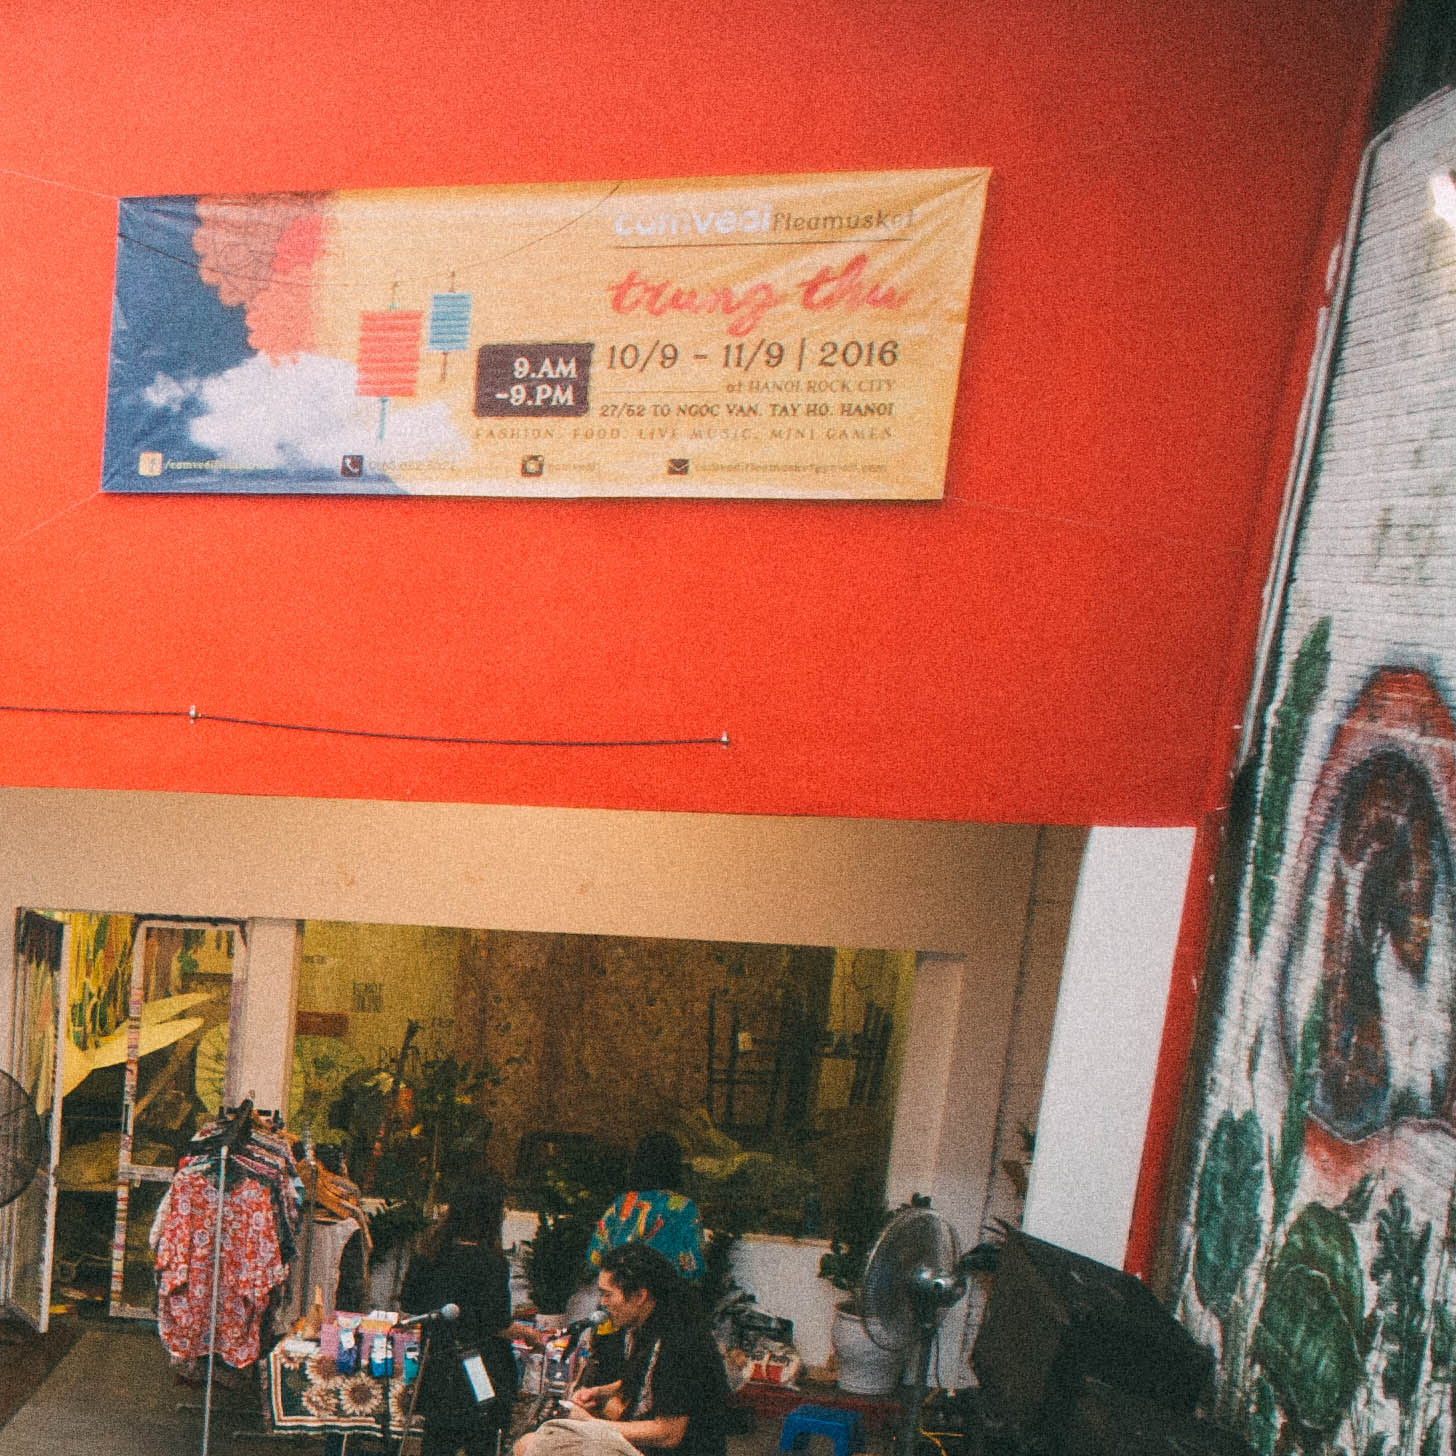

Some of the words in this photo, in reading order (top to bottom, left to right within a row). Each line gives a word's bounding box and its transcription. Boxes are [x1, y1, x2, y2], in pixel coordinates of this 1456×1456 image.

[607, 270, 779, 337] trung
[797, 253, 916, 312] thu
[607, 340, 679, 372] 10/9
[723, 338, 786, 370] 11/9
[819, 339, 899, 367] 2016
[513, 357, 578, 380] 9.AM
[749, 380, 800, 393] HANOI
[807, 380, 850, 393] ROCK
[858, 379, 896, 392] CITY
[770, 403, 800, 417] TAY
[841, 402, 895, 417] HANOI
